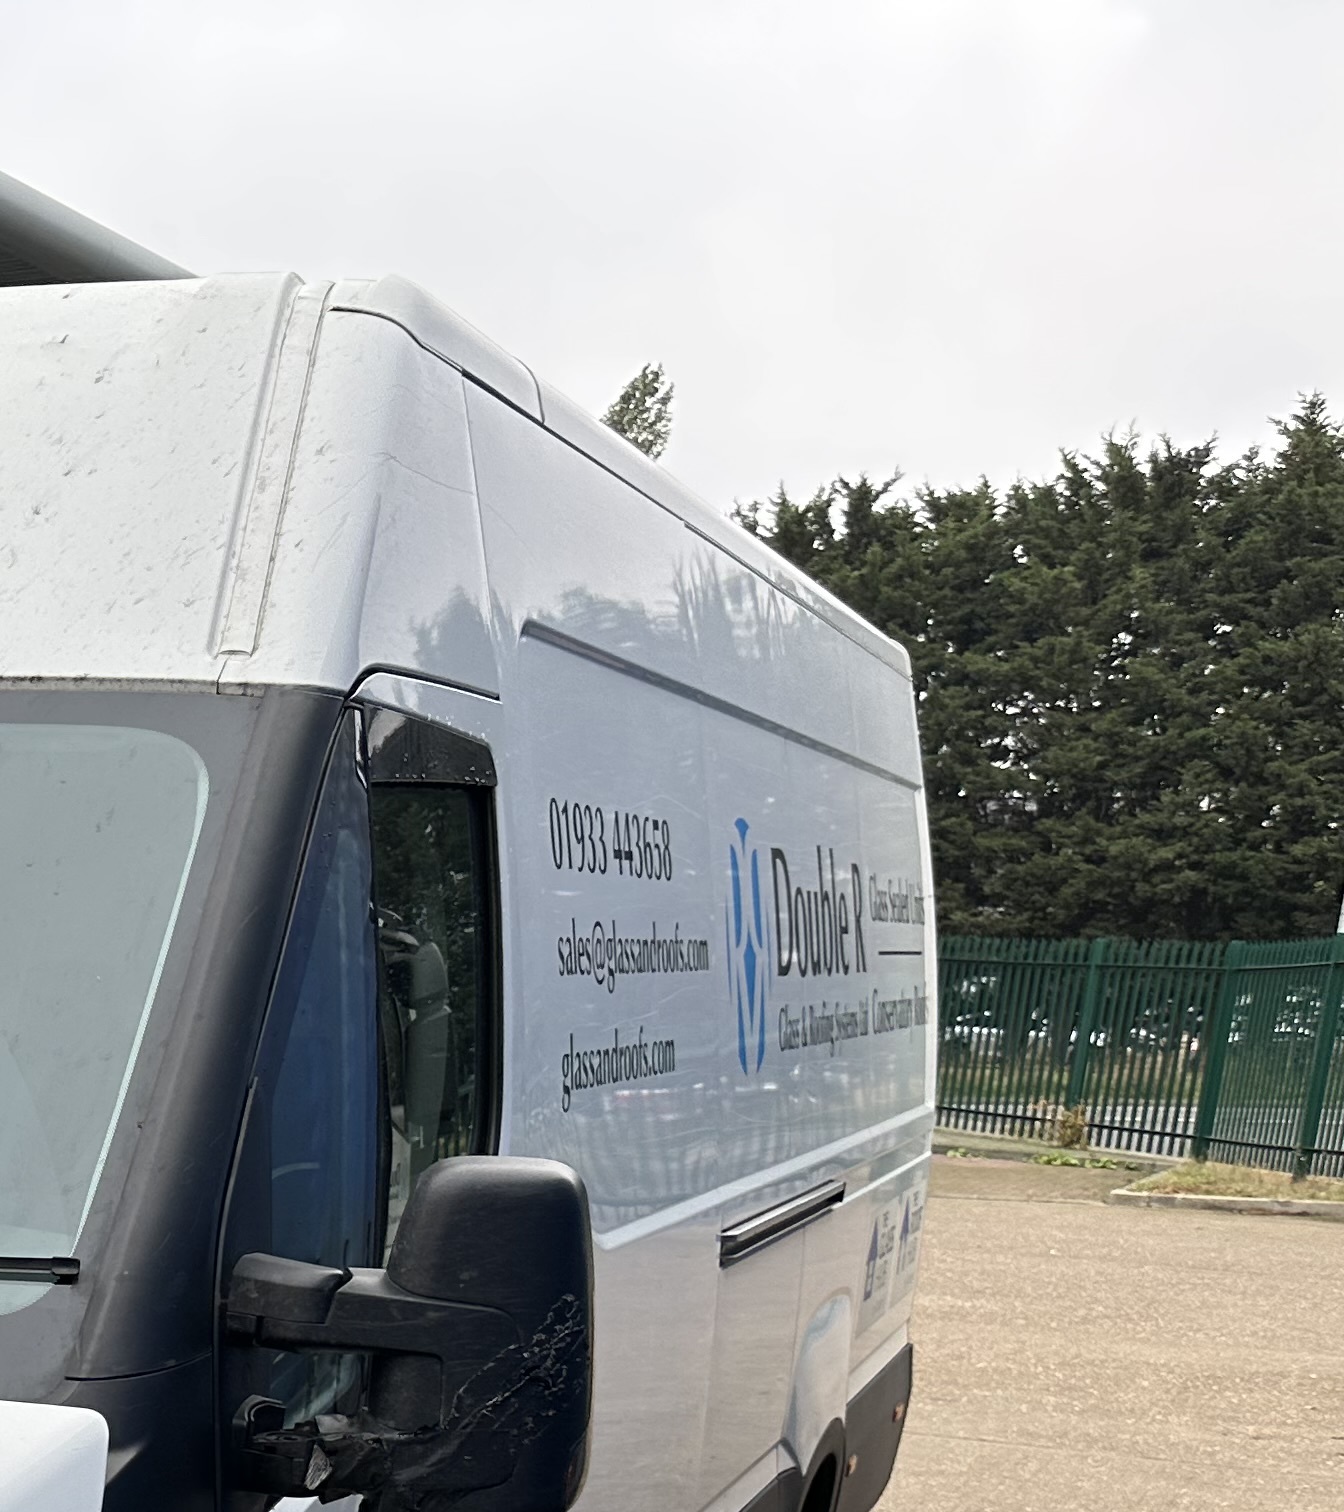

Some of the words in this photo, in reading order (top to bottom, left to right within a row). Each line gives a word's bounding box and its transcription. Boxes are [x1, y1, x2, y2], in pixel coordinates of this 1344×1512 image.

[549, 797, 607, 875] 01933
[613, 810, 672, 881] 443658
[770, 845, 849, 977] Double
[851, 863, 867, 973] R
[558, 917, 709, 993] sales@glassandroofs.com
[562, 1026, 676, 1113] glassandroofs.com
